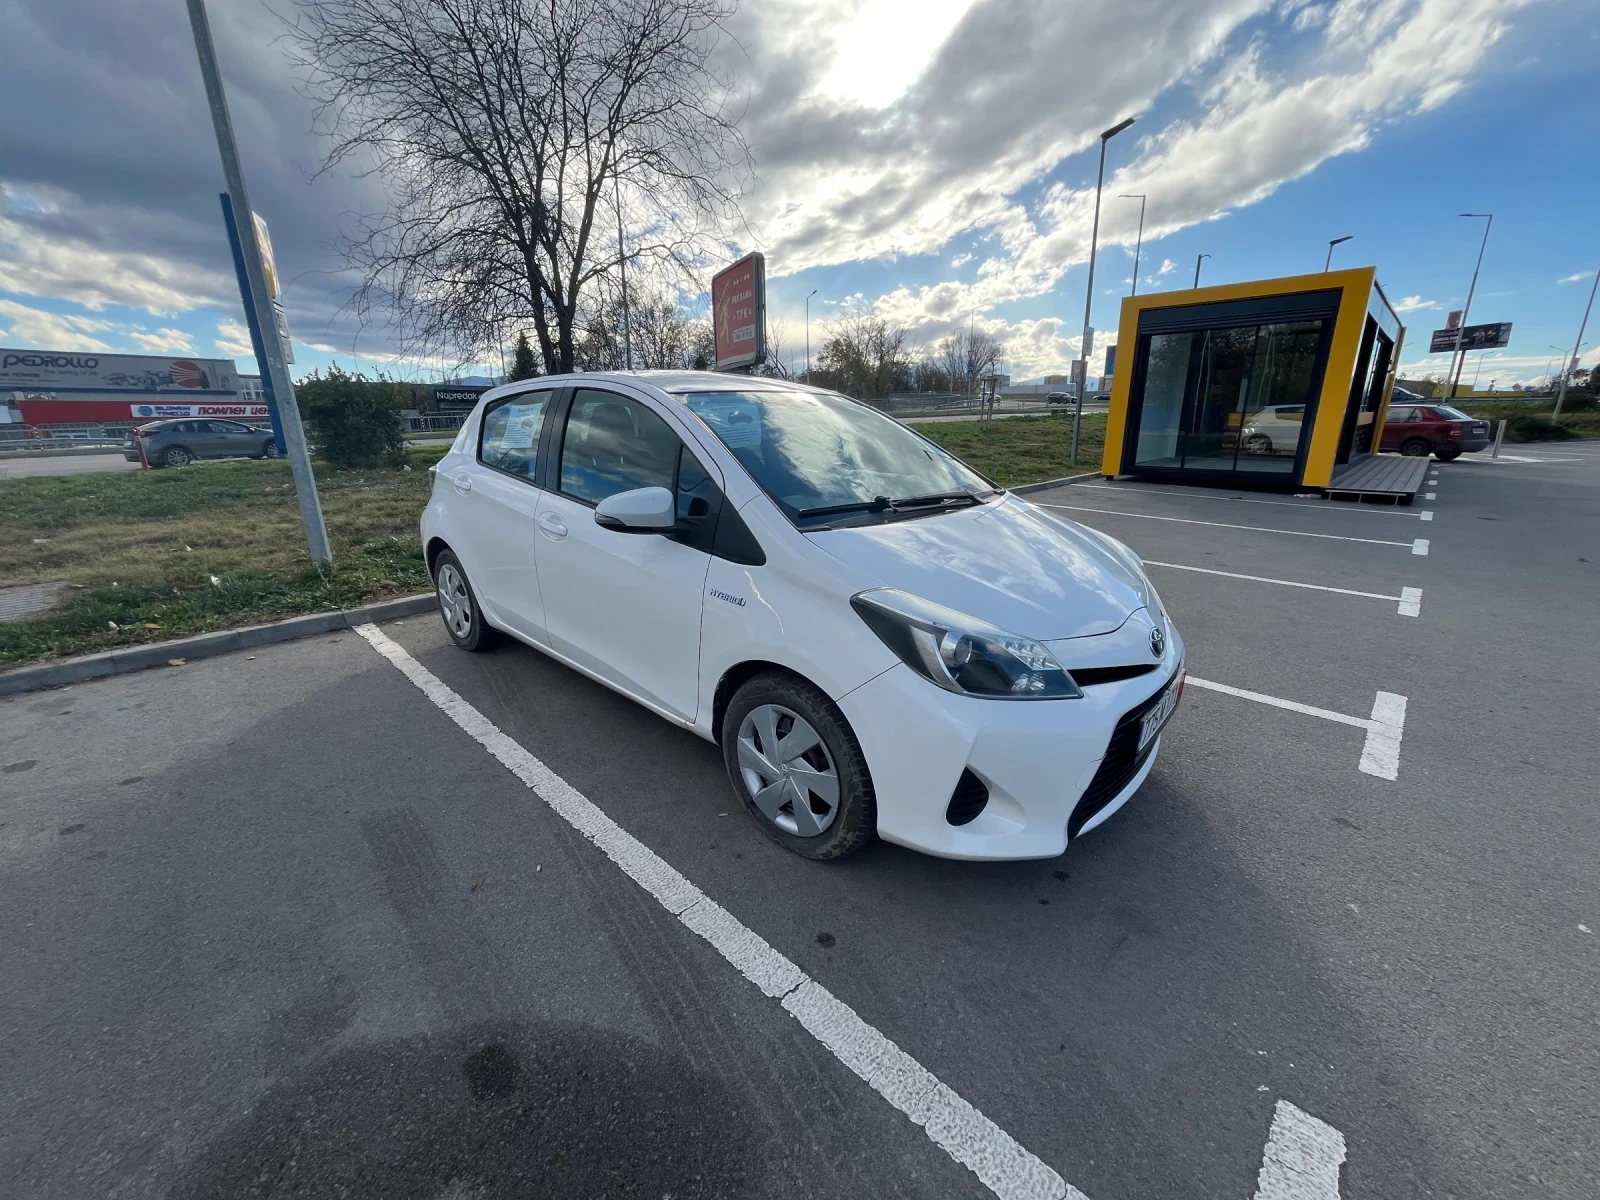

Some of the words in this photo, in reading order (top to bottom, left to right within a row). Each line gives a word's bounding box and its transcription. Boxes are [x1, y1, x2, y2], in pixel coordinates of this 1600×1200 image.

[436, 391, 478, 400] Napredak
[198, 406, 246, 415] ПОМПЕН
[709, 588, 747, 607] HYBRID
